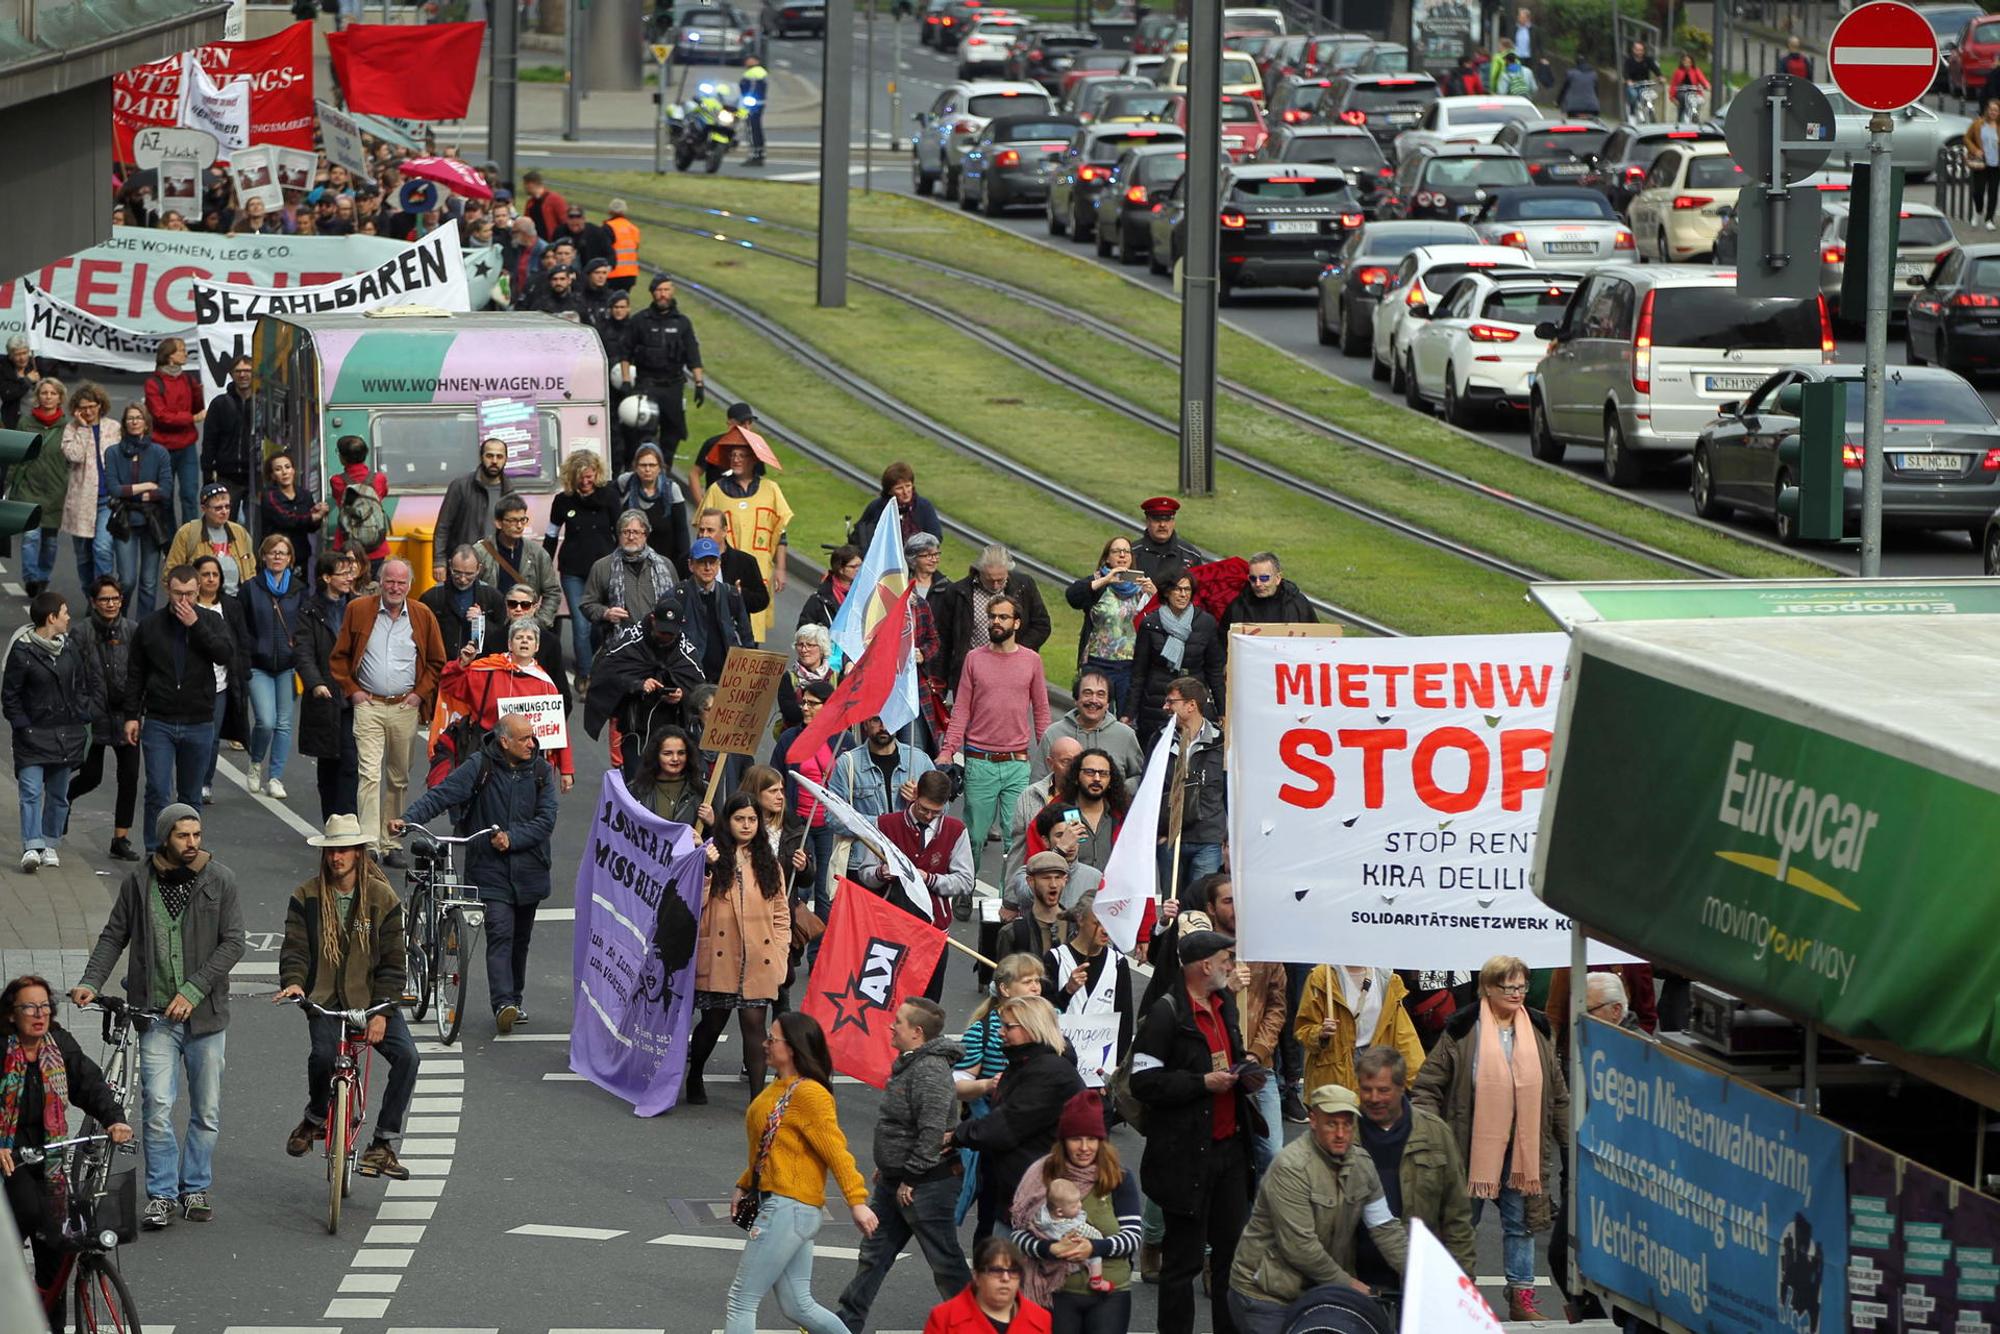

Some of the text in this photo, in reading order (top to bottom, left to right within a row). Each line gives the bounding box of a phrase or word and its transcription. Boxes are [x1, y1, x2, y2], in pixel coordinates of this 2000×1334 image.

[140, 131, 162, 151] AZ
[141, 240, 215, 260] WOHNEN,
[220, 249, 249, 261] LEG
[253, 249, 262, 260] &
[267, 246, 293, 258] CO.
[361, 376, 565, 392] WWW.WOHNEN-WAGEN.DE
[1772, 601, 1957, 615] Europcar
[727, 656, 786, 677] WIR BLEIBEN
[722, 674, 770, 691] WO WIR
[1275, 662, 1553, 709] MIETENW
[714, 706, 759, 729] MIETEN
[1278, 726, 1554, 814] STOP
[1718, 739, 1880, 882] Europcar
[1384, 830, 1538, 854] STOP REN
[1362, 863, 1426, 889] KIRA
[1352, 911, 1549, 930] SOLIDARITÄTSNETZWERK
[1701, 895, 1770, 961] moving
[1811, 938, 1857, 996] way
[1590, 1049, 1814, 1208] Gegen Mietenwahnsinn,
[1729, 1201, 1769, 1257] und
[1590, 1195, 1709, 1315] Verdrängung!
